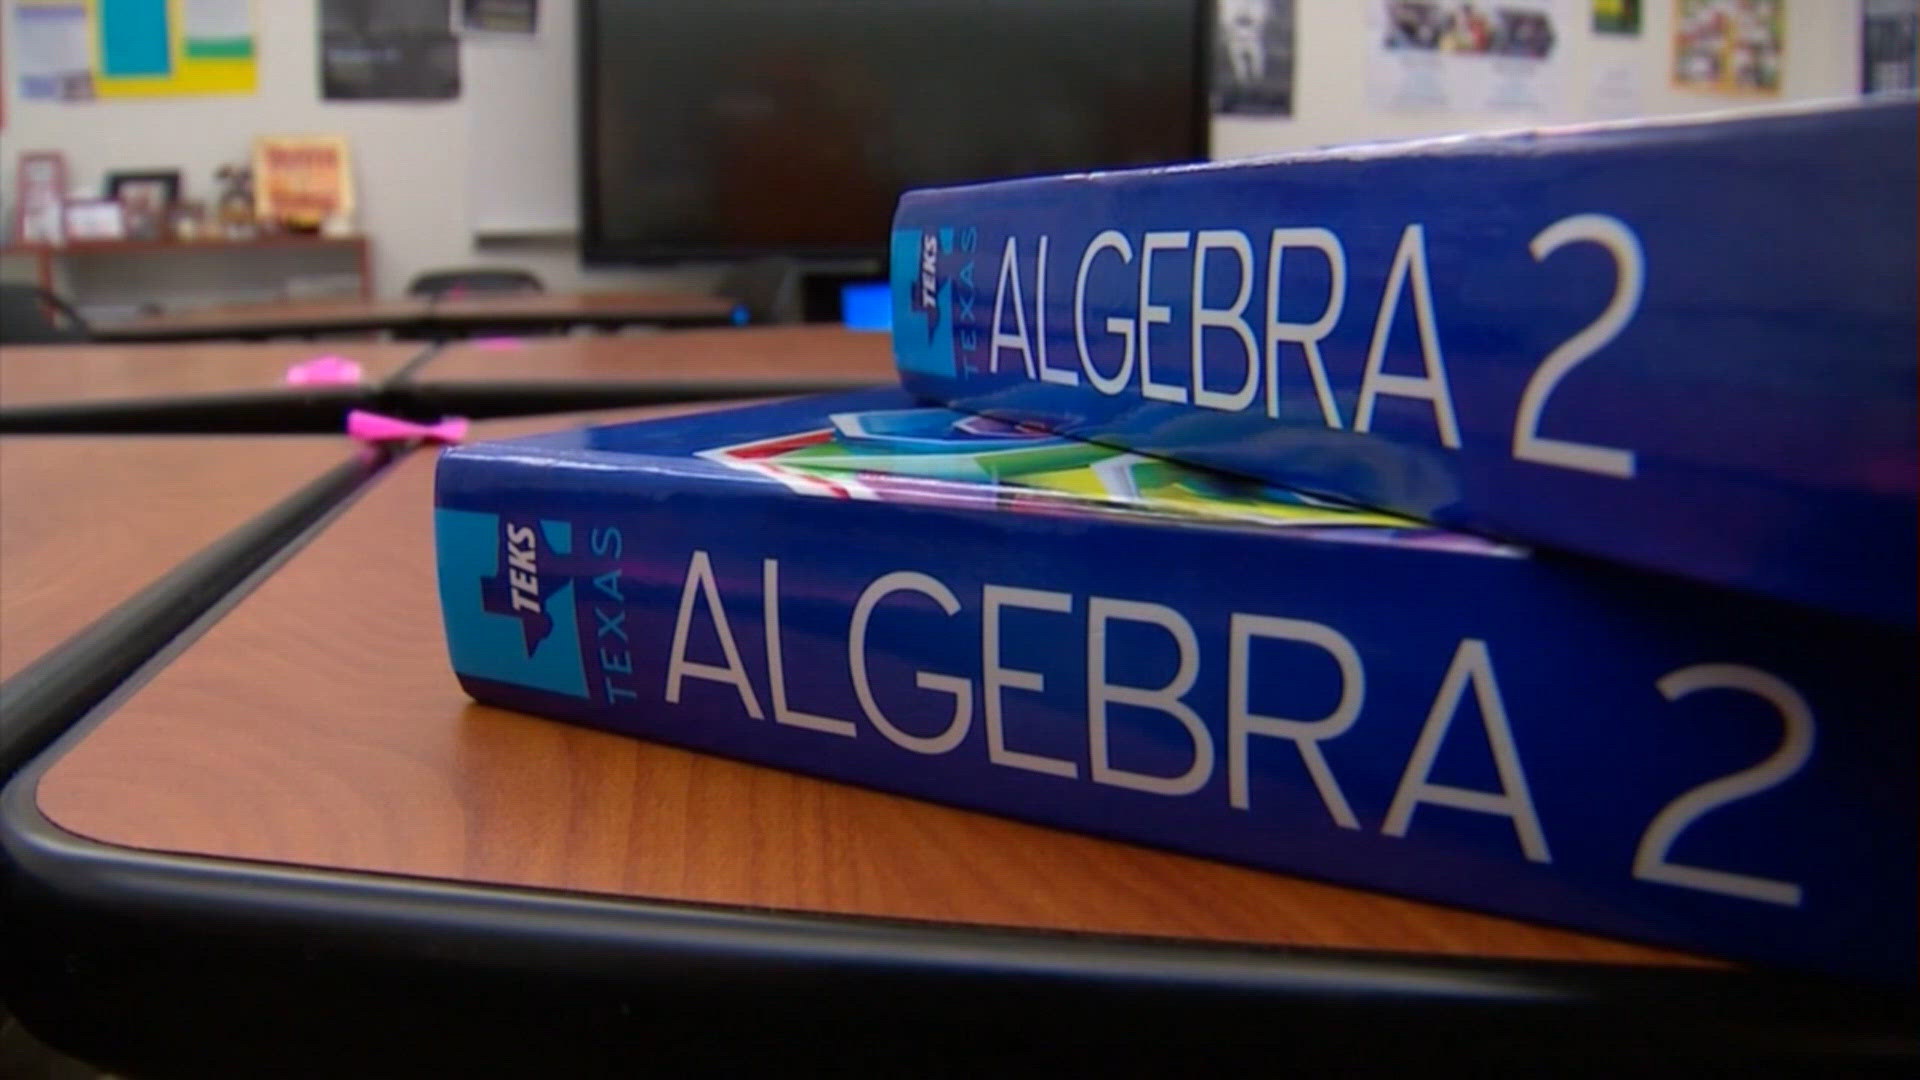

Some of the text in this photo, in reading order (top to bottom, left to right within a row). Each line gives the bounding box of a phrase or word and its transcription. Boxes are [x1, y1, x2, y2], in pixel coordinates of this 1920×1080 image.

[922, 234, 937, 307] TEKS
[960, 226, 977, 380] TEXAS
[989, 213, 1646, 479] ALGEBRA 2
[507, 523, 541, 613] TEKS
[592, 528, 637, 704] TEXAS
[665, 549, 1817, 907] ALGEBRA 2
